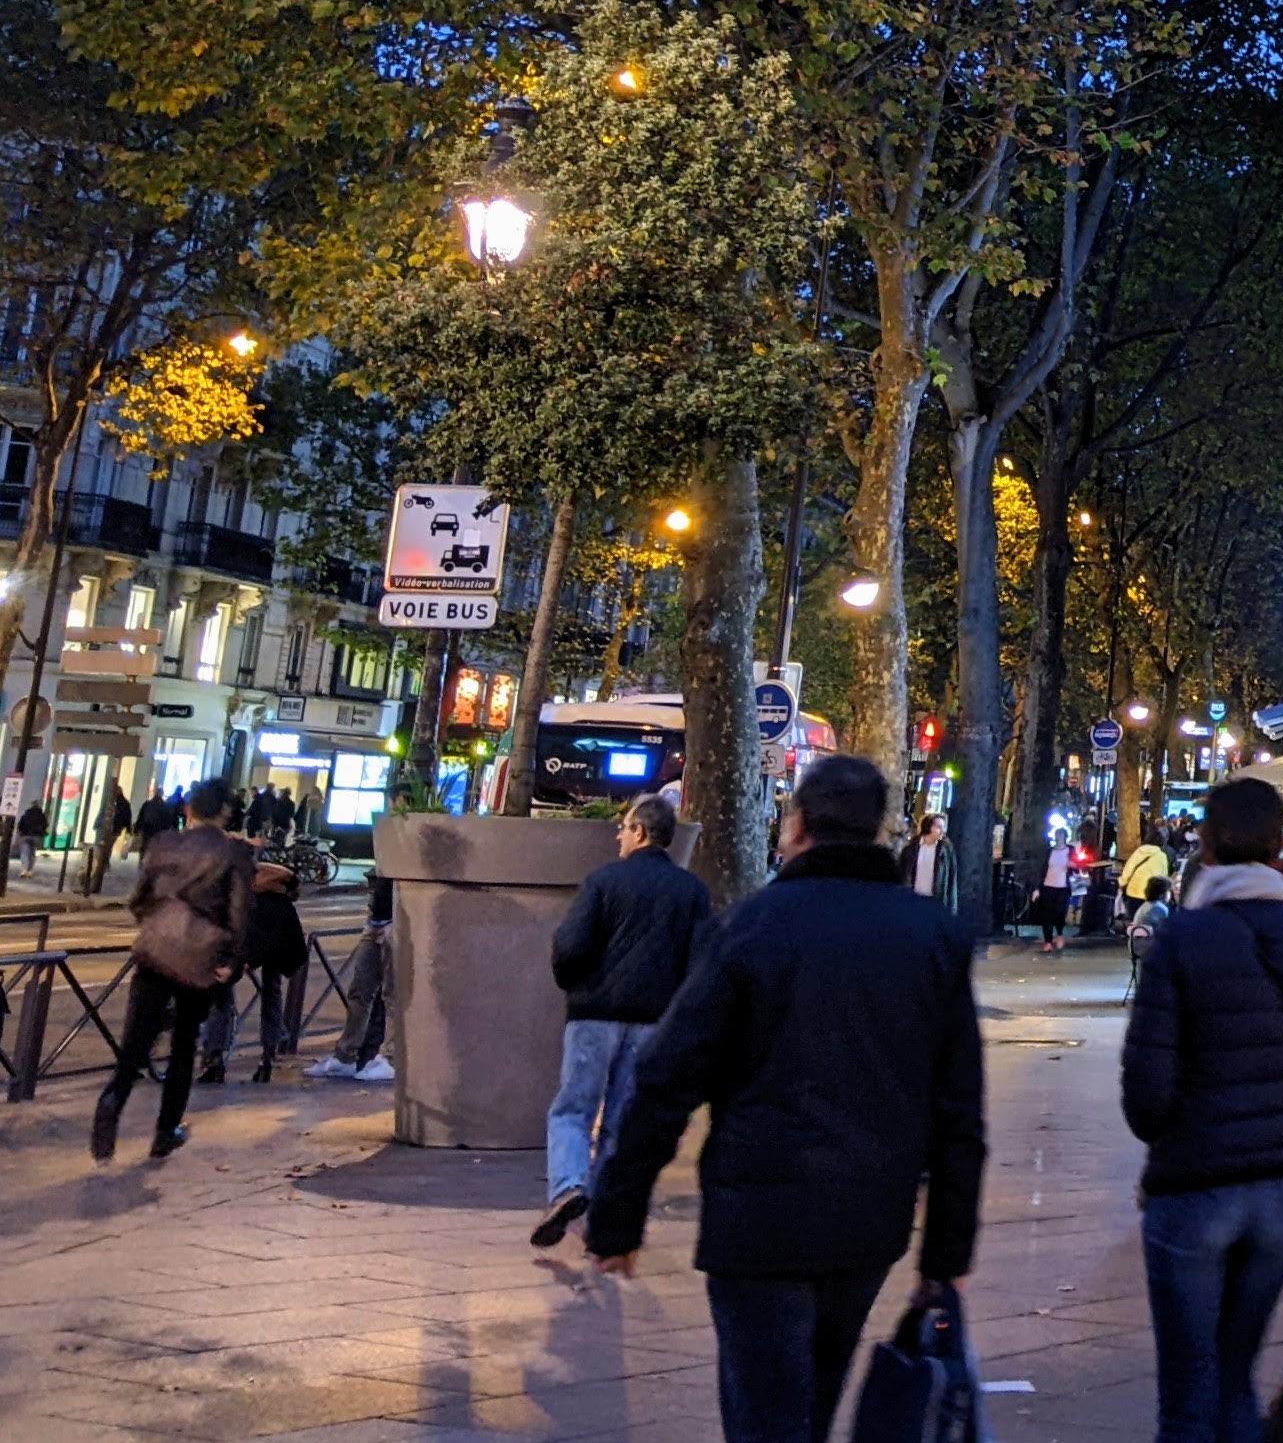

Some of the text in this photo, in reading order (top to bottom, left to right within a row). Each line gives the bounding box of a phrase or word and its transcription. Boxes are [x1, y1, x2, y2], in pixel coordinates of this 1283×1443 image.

[394, 577, 490, 589] Vidéo-verbalisation
[389, 601, 489, 620] VOIE BUS
[641, 735, 663, 745] 5535
